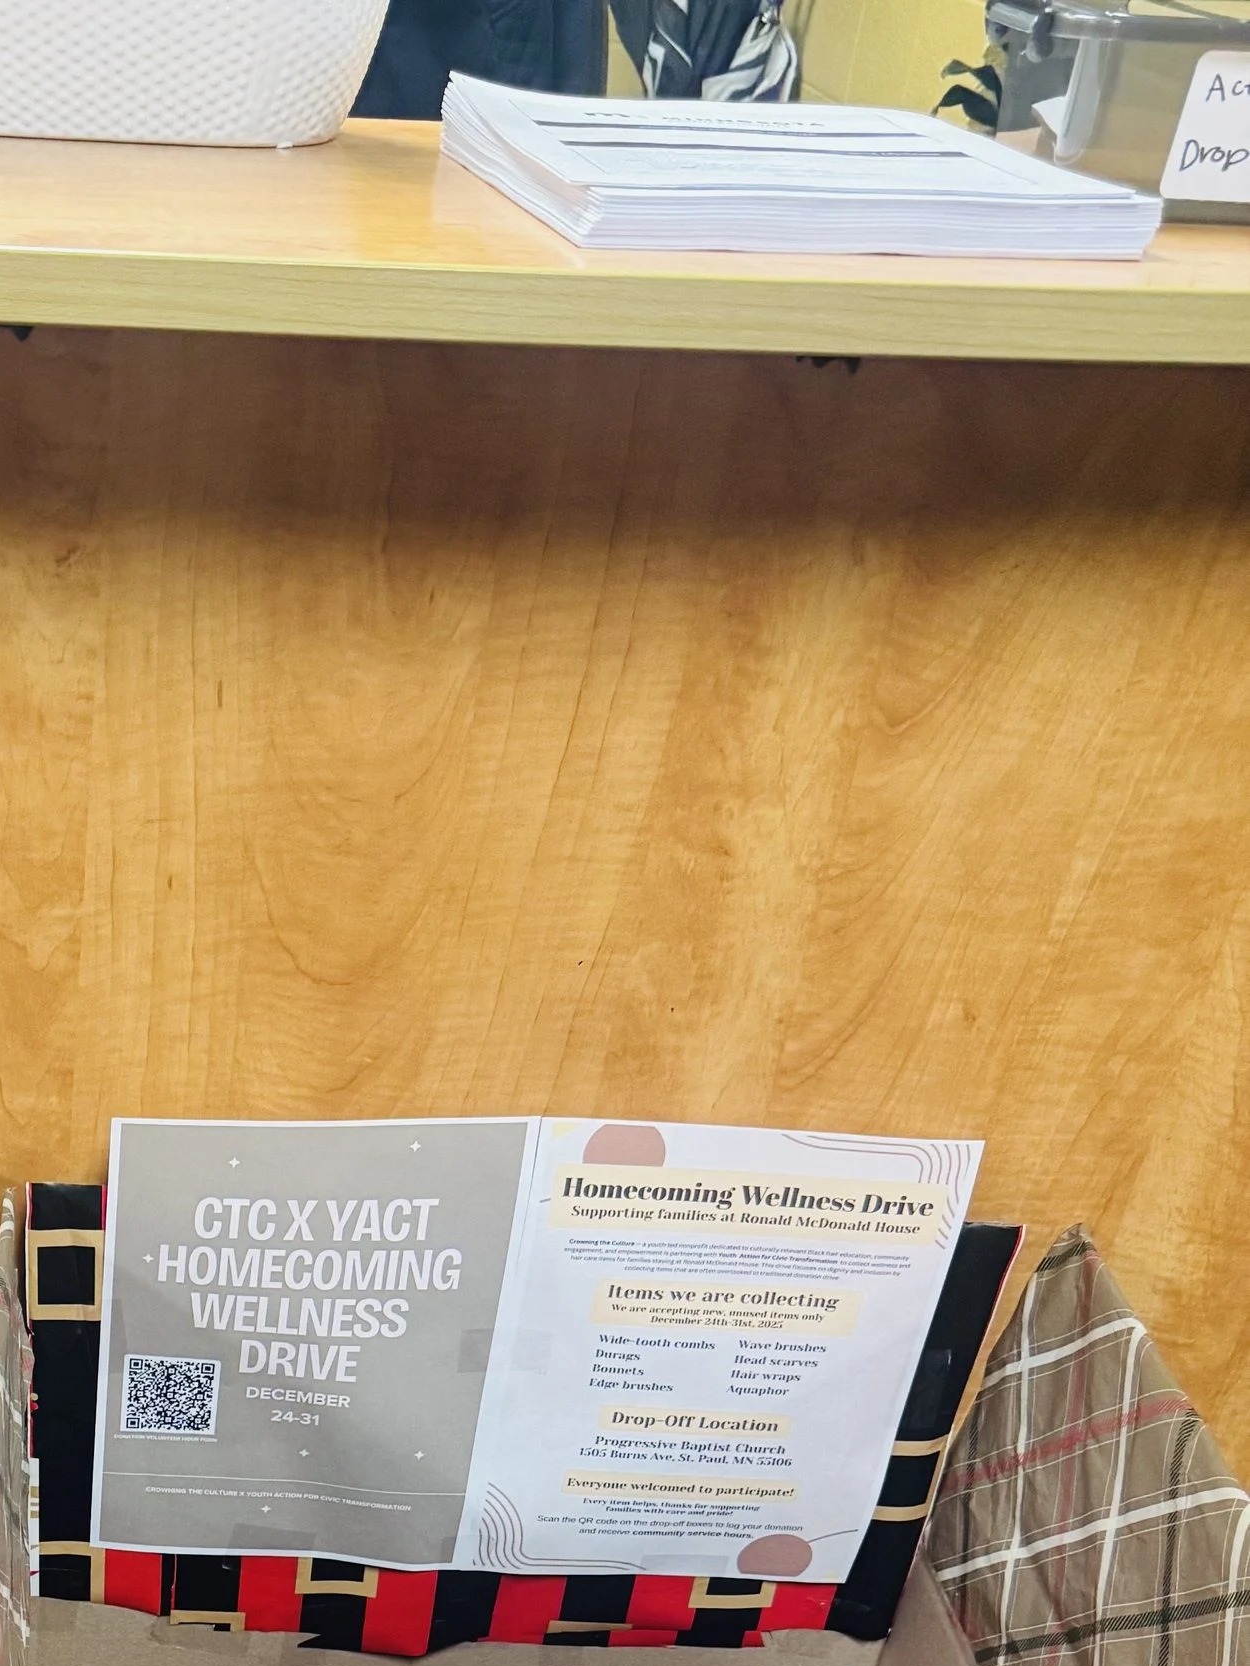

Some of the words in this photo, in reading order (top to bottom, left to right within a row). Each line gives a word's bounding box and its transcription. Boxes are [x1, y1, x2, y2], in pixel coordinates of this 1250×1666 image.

[1179, 138, 1250, 172] Drop
[563, 1177, 736, 1210] Homecoming
[742, 1185, 856, 1212] Wellness
[861, 1194, 934, 1216] Drive
[194, 1197, 277, 1241] CTC
[283, 1200, 318, 1241] X
[326, 1198, 440, 1242] YACT
[571, 1205, 654, 1221] Supporting
[657, 1209, 717, 1221] families
[720, 1213, 735, 1222] at
[740, 1213, 792, 1226] Ronald
[796, 1216, 871, 1231] McDonald
[875, 1221, 920, 1234] House
[158, 1244, 462, 1290] HOMECOMING
[608, 1285, 664, 1300] Items
[670, 1291, 696, 1301] we
[702, 1292, 735, 1303] are
[740, 1291, 840, 1311] collecting
[190, 1292, 409, 1338] WELLNESS
[612, 1304, 627, 1312] We
[649, 1307, 700, 1316] accepting
[729, 1310, 768, 1318] unused
[770, 1311, 799, 1320] items
[801, 1313, 823, 1323] only
[650, 1315, 702, 1325] December
[757, 1320, 784, 1329] 2025
[599, 1334, 671, 1347] Wide-tooth
[674, 1340, 715, 1349] combs
[739, 1340, 772, 1349] Wave
[774, 1342, 826, 1352] brushes
[239, 1339, 361, 1382] DRIVE
[596, 1349, 640, 1362] Durags
[734, 1355, 767, 1365] Head
[769, 1359, 818, 1367] scarves
[592, 1363, 644, 1376] Bonnets
[730, 1370, 759, 1379] Hair
[762, 1373, 801, 1383] wraps
[589, 1378, 619, 1389] Edge
[622, 1380, 673, 1391] brushes
[728, 1385, 790, 1397] Aquaphor
[246, 1387, 351, 1408] DECEMBER
[270, 1410, 319, 1426] 24-31
[612, 1411, 696, 1428] Drop-Off
[699, 1417, 778, 1432] Location
[595, 1436, 677, 1449] Progressive
[681, 1441, 730, 1453] Baptist
[735, 1443, 786, 1454] Church
[580, 1447, 607, 1457] 1505
[610, 1450, 647, 1460] Burns
[678, 1453, 694, 1462] St.
[733, 1456, 753, 1465] MN
[756, 1456, 792, 1466] 55106
[567, 1478, 627, 1490] Everyone
[631, 1482, 695, 1493] welcomed
[699, 1486, 713, 1494] to
[715, 1487, 794, 1498] participate!
[145, 1486, 187, 1494] CROWNING
[320, 1495, 341, 1503] CIVIC
[342, 1498, 411, 1511] TRANSFORMATION
